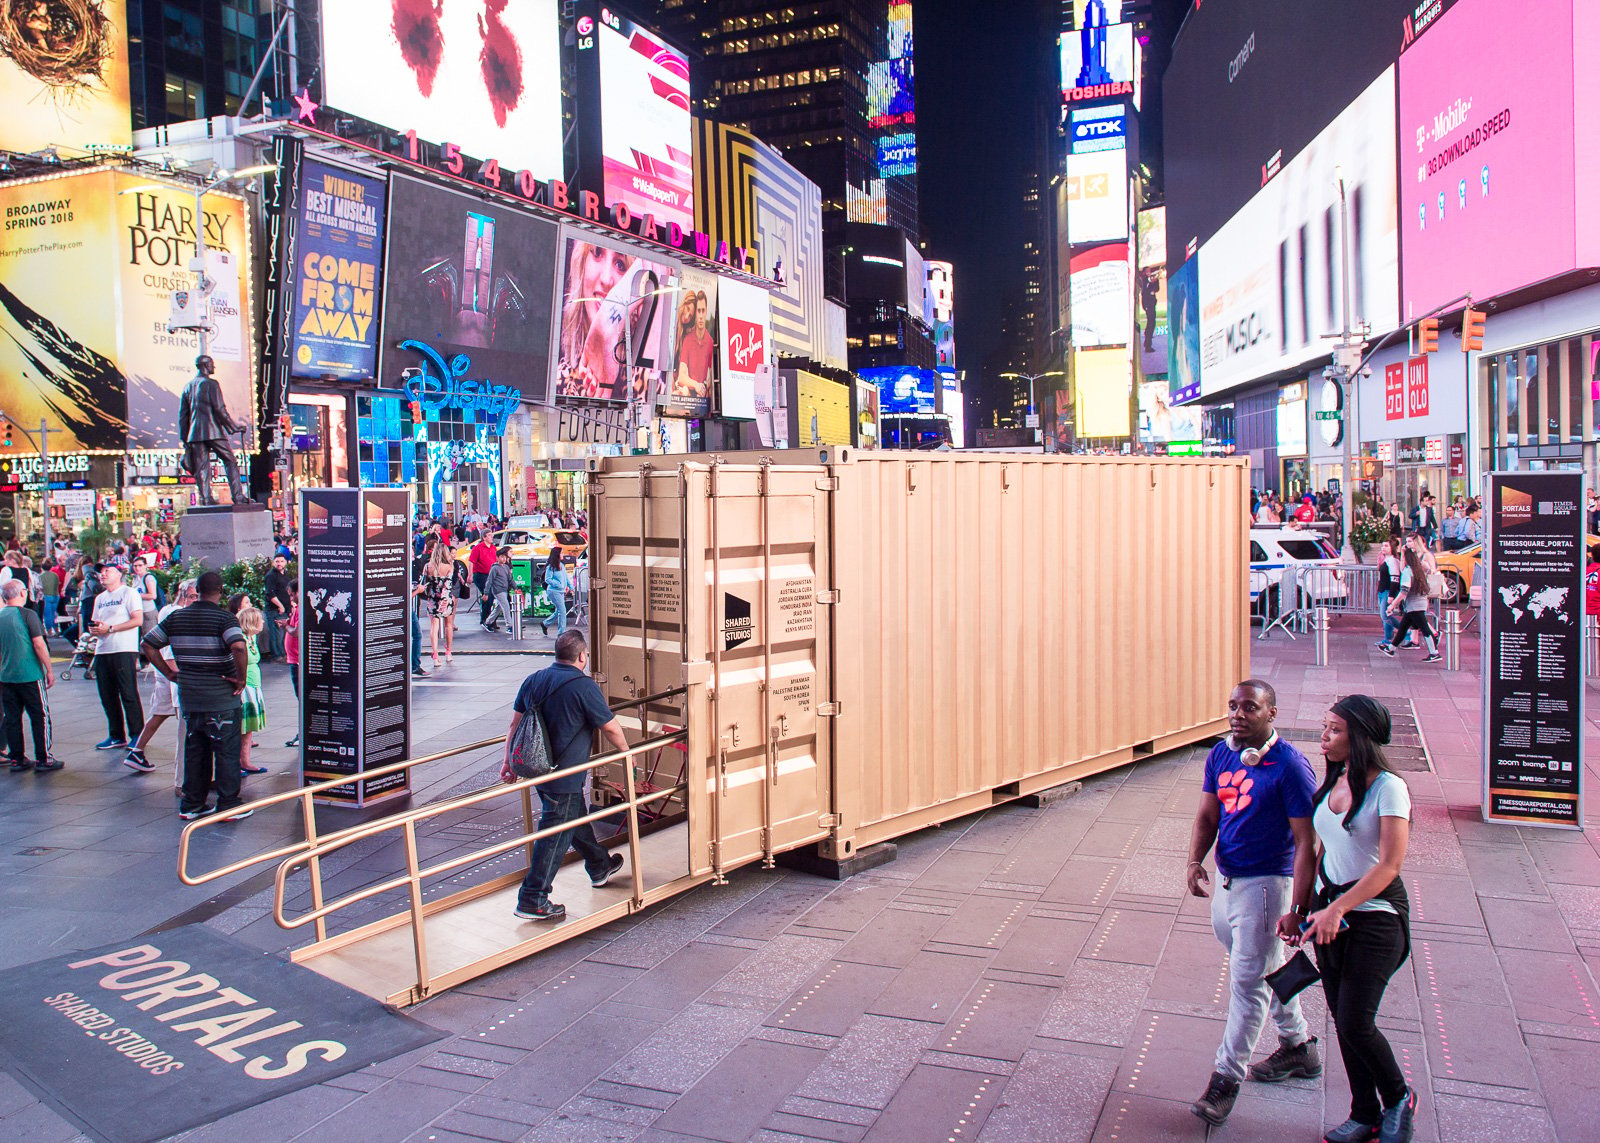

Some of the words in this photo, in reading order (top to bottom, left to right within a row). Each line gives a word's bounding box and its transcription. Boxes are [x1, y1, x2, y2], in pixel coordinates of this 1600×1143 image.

[609, 13, 620, 30] LG
[1415, 1, 1442, 34] MARQUIS
[578, 37, 593, 50] LG
[1228, 31, 1255, 83] camera
[1062, 80, 1134, 102] TOSHIBA
[1087, 119, 1122, 135] TDK
[1427, 157, 1438, 177] 3G
[1438, 128, 1482, 171] DOWNLOAD
[1482, 108, 1511, 143] SPEED
[323, 174, 365, 203] WINNER!
[632, 176, 679, 206] #WallpaperTV
[6, 199, 71, 218] BROADWAY
[306, 189, 333, 214] BEST
[334, 197, 377, 227] MUSICAL
[5, 216, 46, 230] SPRING
[51, 212, 74, 224] 2018
[305, 210, 316, 222] ALL
[316, 213, 338, 228] ACROSS
[355, 223, 377, 237] AMERICA
[304, 252, 375, 289] COME
[299, 307, 372, 342] AWAY
[153, 335, 198, 349] SPRING
[1410, 363, 1426, 386] UNI
[1410, 388, 1427, 414] QLO
[1317, 412, 1324, 420] W
[1326, 411, 1335, 420] 46
[11, 455, 90, 475] LUGGAGE
[133, 452, 178, 467] GIFTS
[1499, 540, 1574, 548] TIMESSQUARE_PORTAL
[786, 579, 812, 587] AFGHANISTAN
[725, 617, 751, 628] SHARED
[725, 630, 751, 642] STUDIOS
[790, 676, 810, 684] MYANMAR
[773, 686, 793, 695] PALESTINE
[1498, 798, 1572, 810] TIMESSQUAREPORTAL.COM
[68, 944, 347, 1080] PORTALS
[43, 991, 185, 1076] SHARED_STUDIOS
